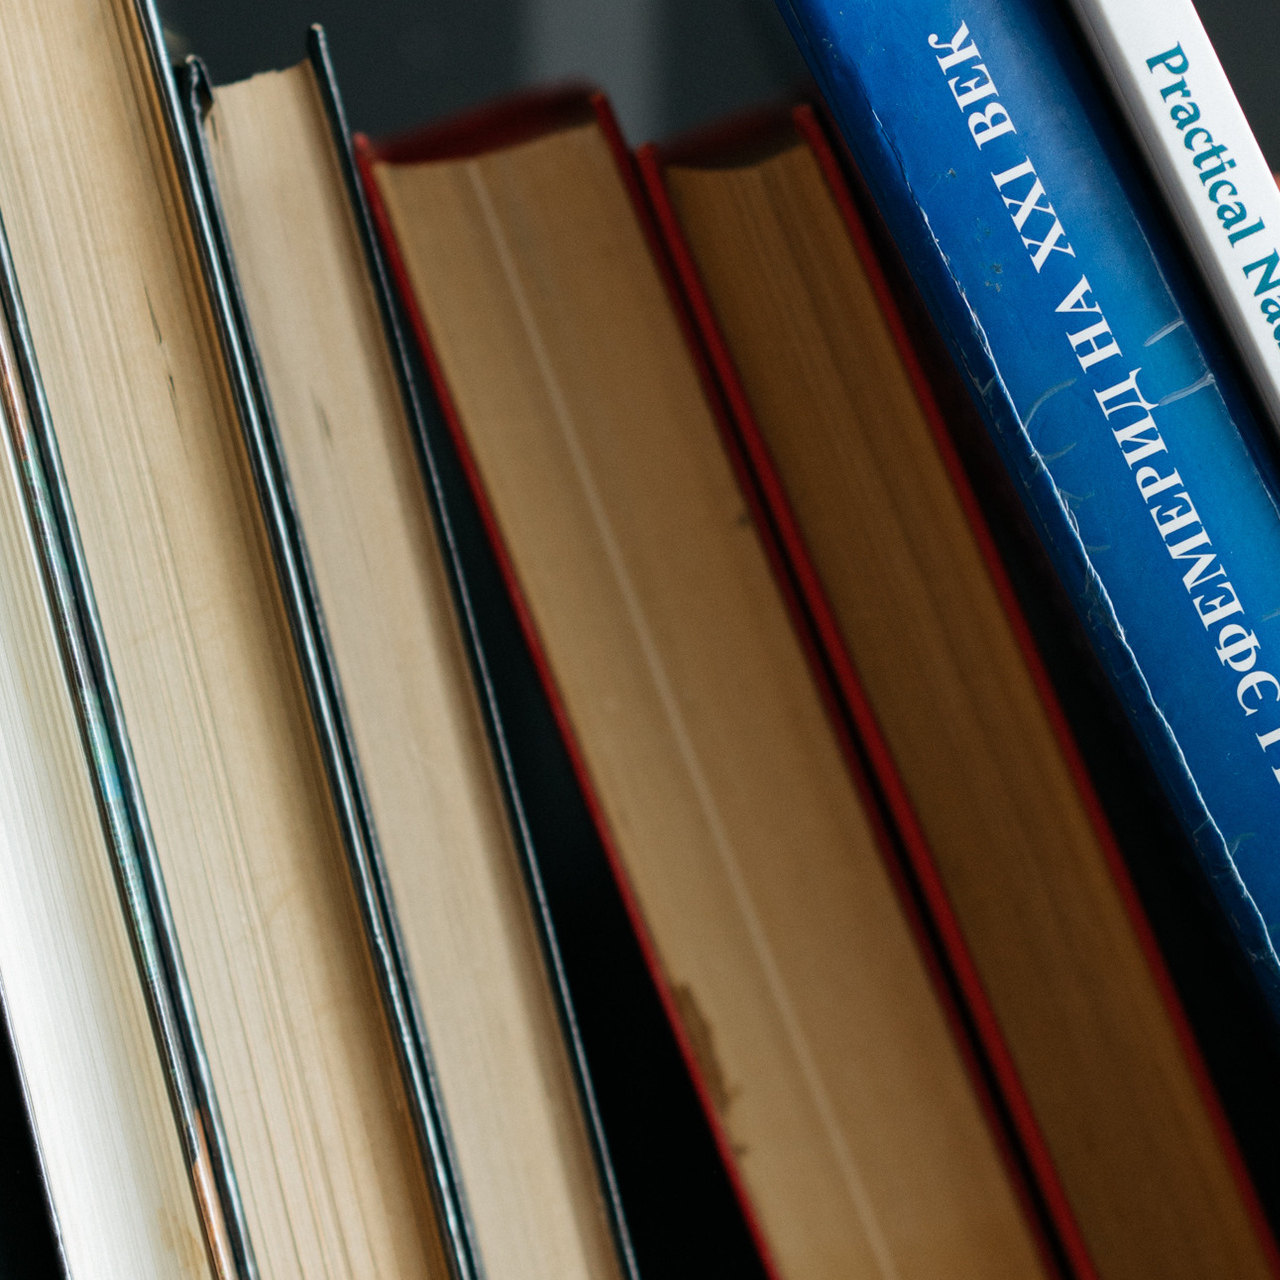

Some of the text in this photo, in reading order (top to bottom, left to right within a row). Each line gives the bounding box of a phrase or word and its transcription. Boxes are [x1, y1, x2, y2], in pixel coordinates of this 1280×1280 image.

[927, 19, 1018, 151] ВЕК
[1144, 40, 1267, 250] Practical
[990, 155, 1076, 274] XXI
[1054, 274, 1123, 374] НА
